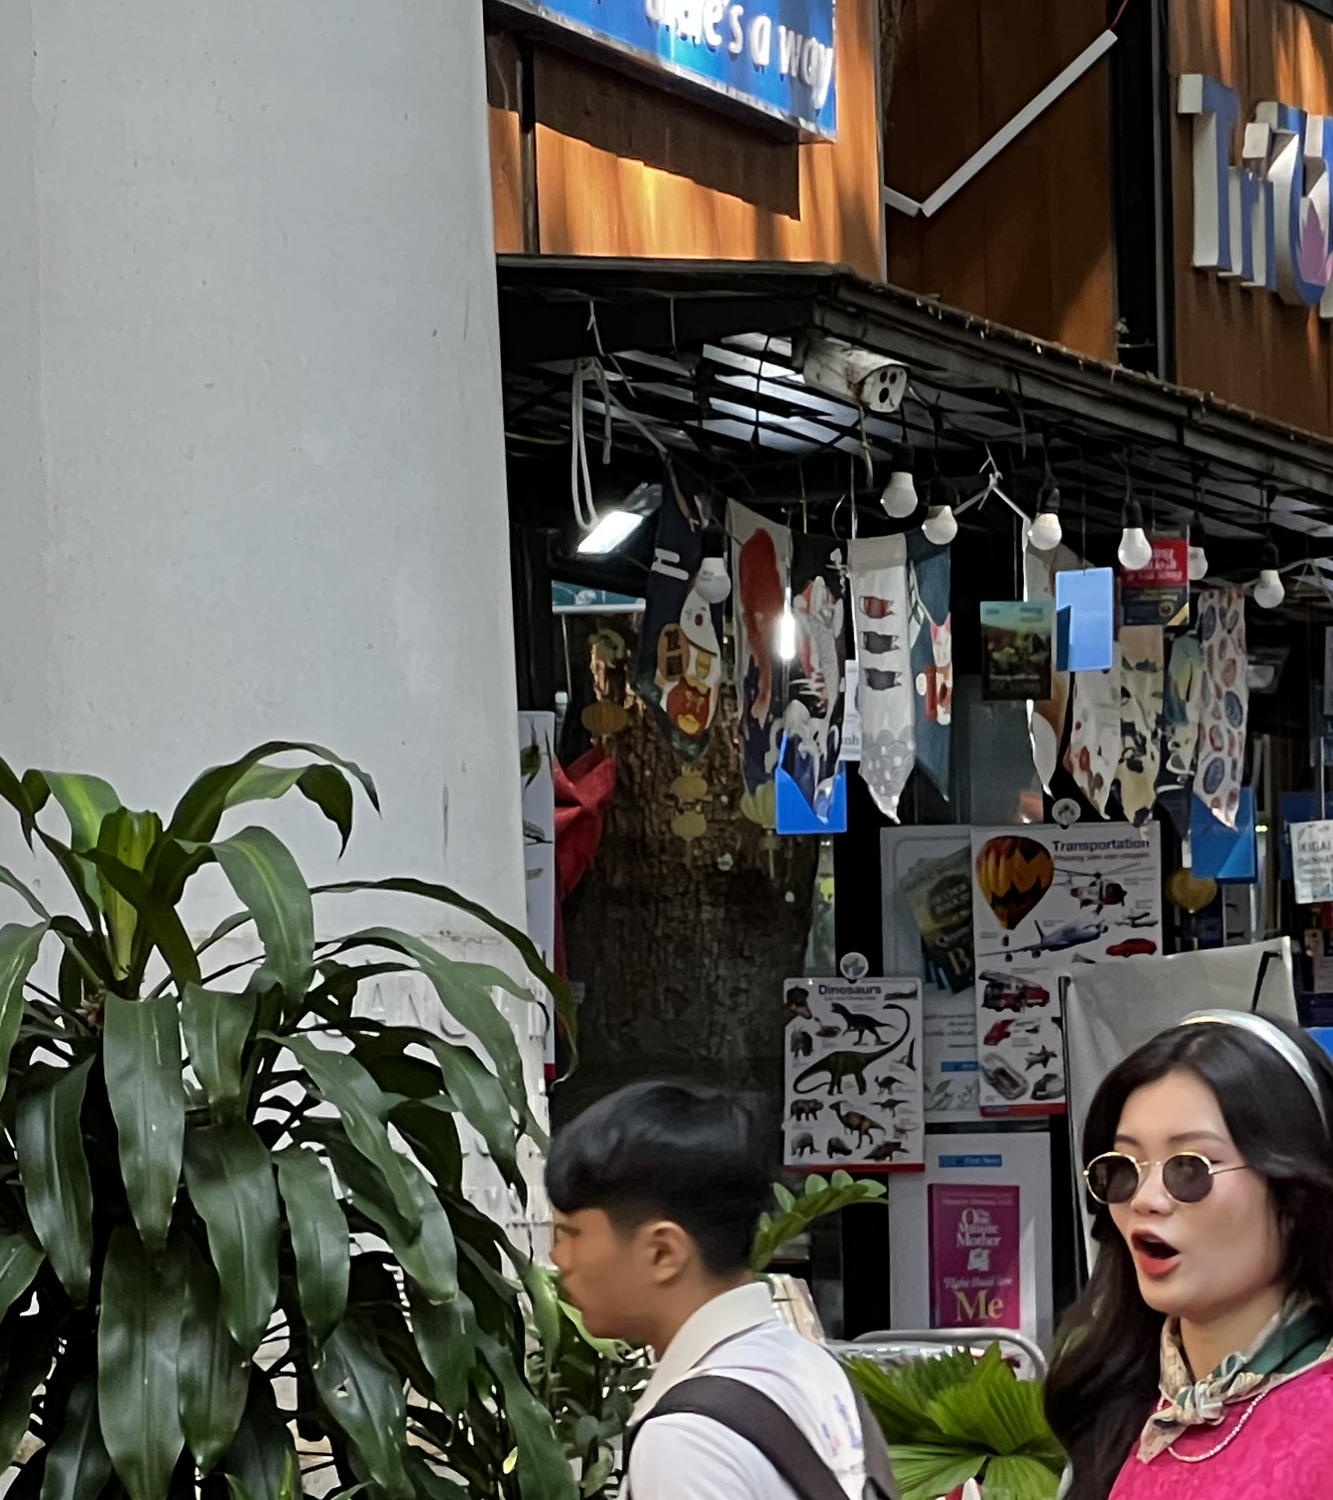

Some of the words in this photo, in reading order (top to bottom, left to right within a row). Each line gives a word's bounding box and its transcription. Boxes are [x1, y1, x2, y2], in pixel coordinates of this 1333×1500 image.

[1052, 839, 1150, 852] Transportation
[818, 985, 882, 995] Dinosaurs
[956, 1233, 1002, 1248] Mother
